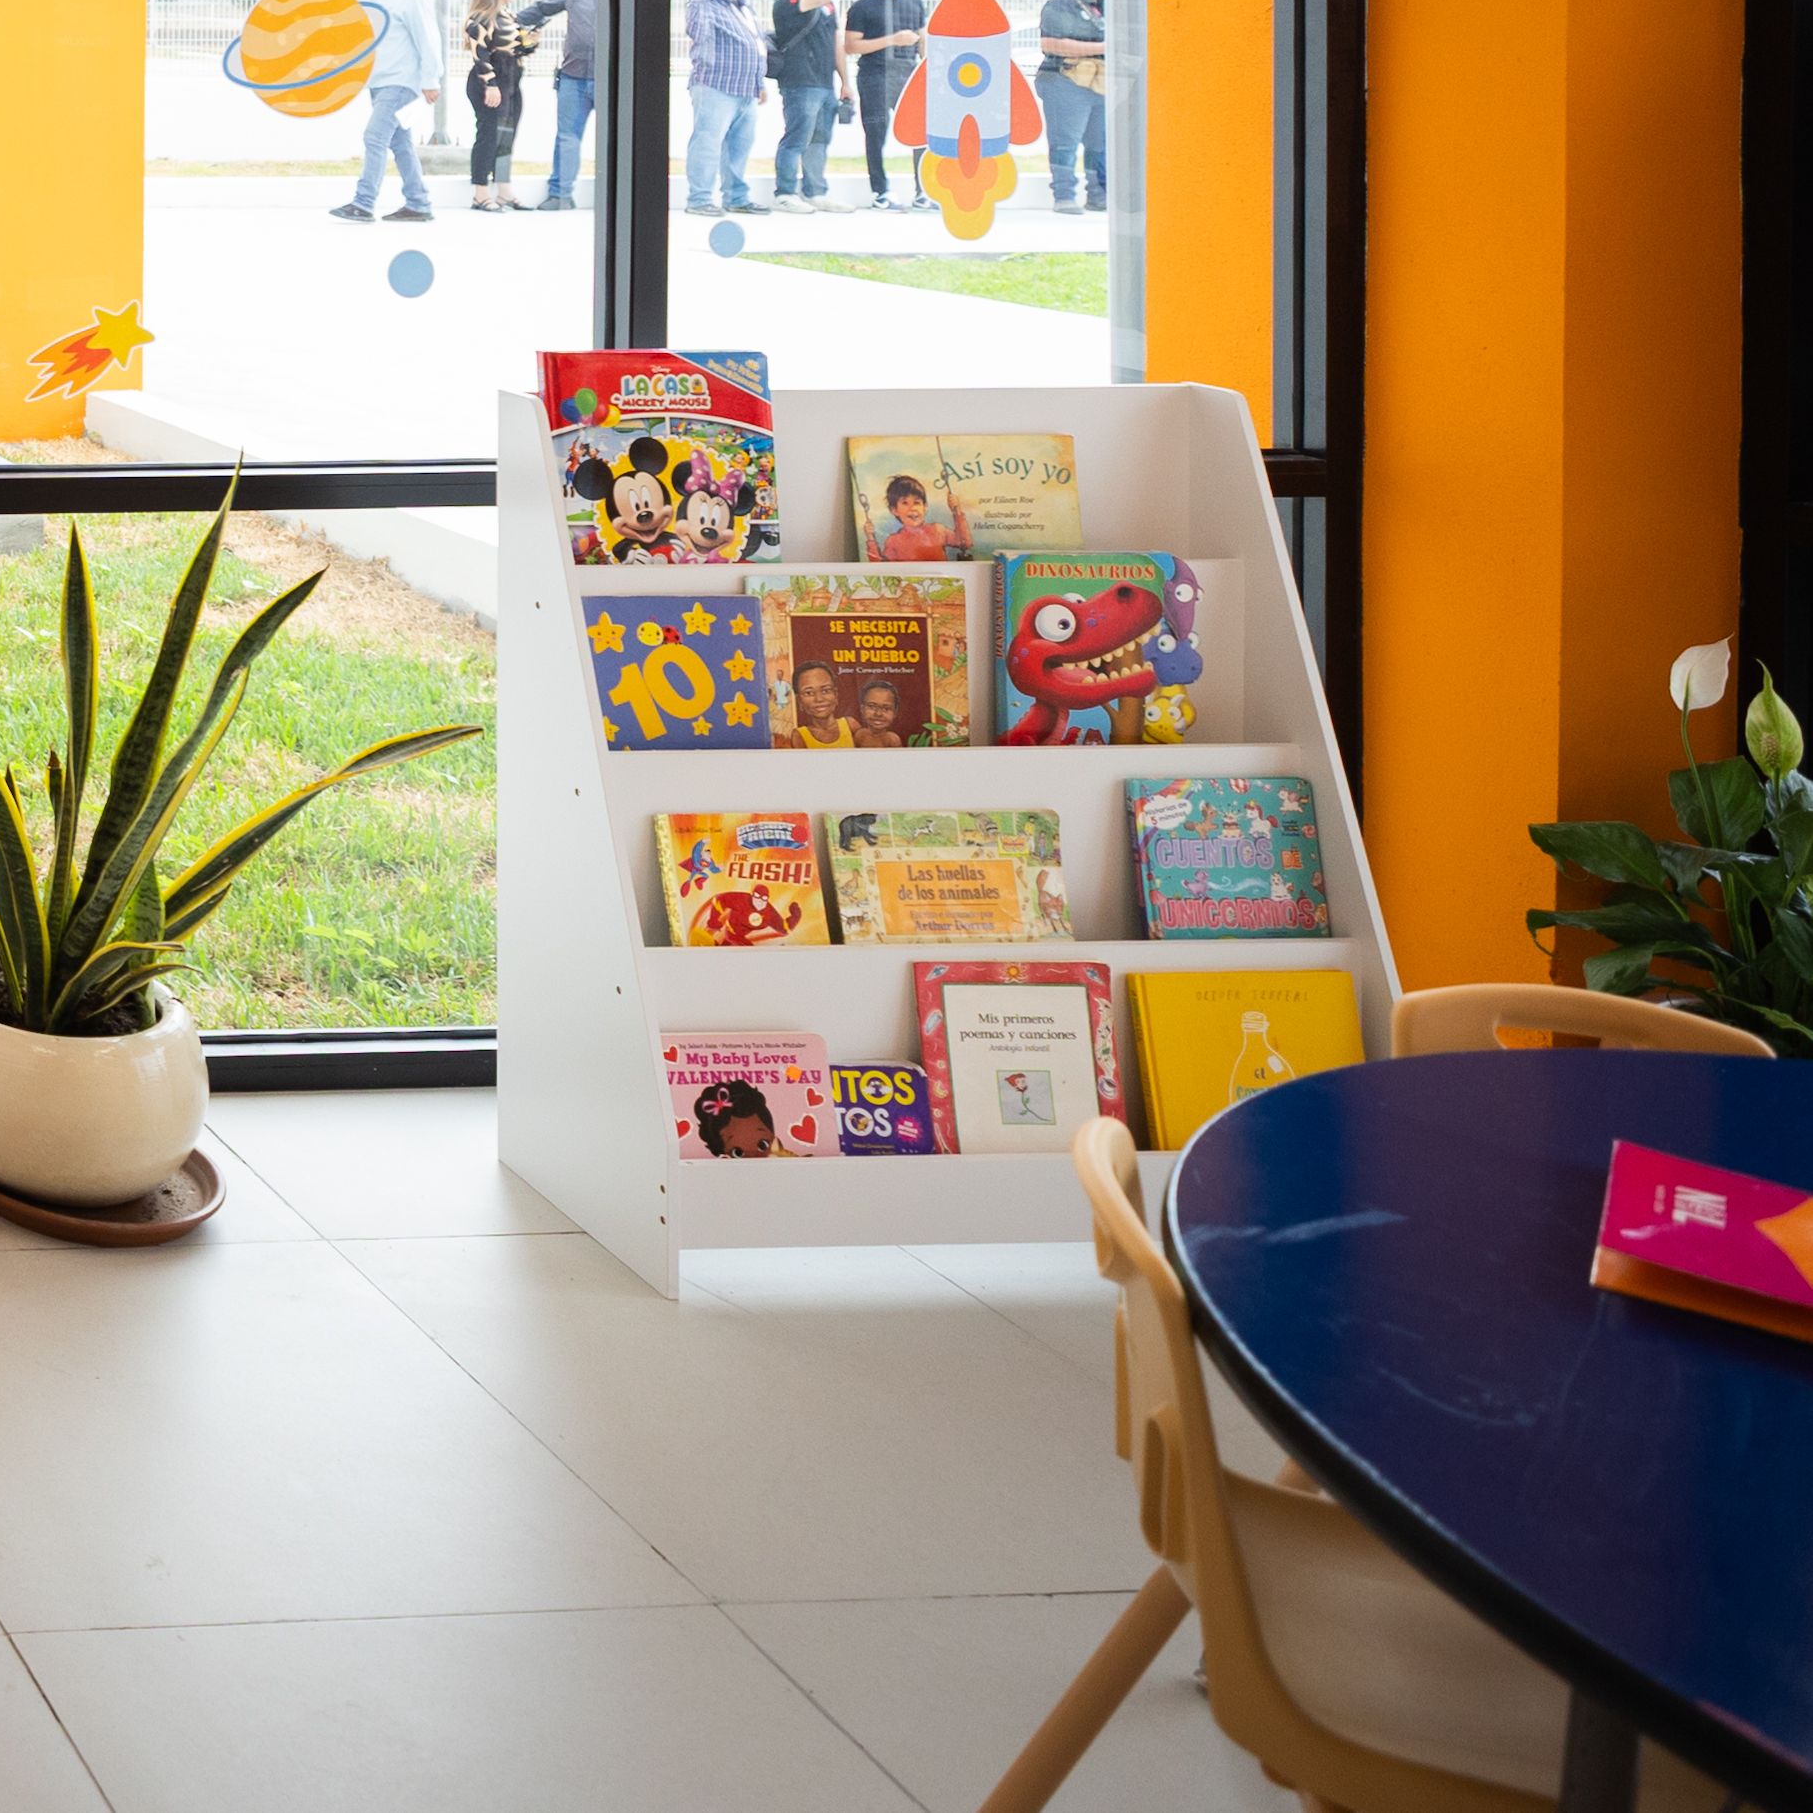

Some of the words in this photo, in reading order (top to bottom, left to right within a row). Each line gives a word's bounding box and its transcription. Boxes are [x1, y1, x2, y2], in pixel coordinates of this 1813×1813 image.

[623, 376, 649, 396] LA
[622, 398, 664, 407] MICKEY
[669, 398, 710, 407] MOUSE
[933, 452, 984, 490] Así
[992, 456, 1035, 480] soy
[1041, 462, 1072, 485] yo
[1026, 562, 1156, 580] DINOSAURIOS
[830, 620, 845, 633] SE
[849, 620, 920, 634] NECESITA
[853, 635, 897, 648] TODO
[833, 650, 856, 662] UN
[860, 650, 920, 663] PUEBLO
[608, 643, 716, 741] 10
[1150, 816, 1158, 825] 5
[734, 853, 750, 862] THE
[1156, 838, 1274, 869] CUENTOS
[1281, 850, 1302, 869] DE
[728, 862, 812, 885] FLASH!
[908, 865, 933, 881] Las
[937, 865, 986, 881] huellas
[897, 886, 913, 900] de
[916, 886, 935, 900] los
[939, 886, 999, 900] animales
[1159, 898, 1316, 929] UNICORNIOS
[978, 1013, 999, 1024] Mis
[1003, 1013, 1054, 1026] primeros
[960, 1030, 1004, 1041] poemas
[1008, 1031, 1015, 1041] y
[1019, 1029, 1077, 1040] canciones
[686, 1053, 707, 1067] My
[712, 1053, 749, 1066] Baby
[754, 1053, 797, 1064] Loves
[667, 1070, 780, 1085] VALENTINE'S
